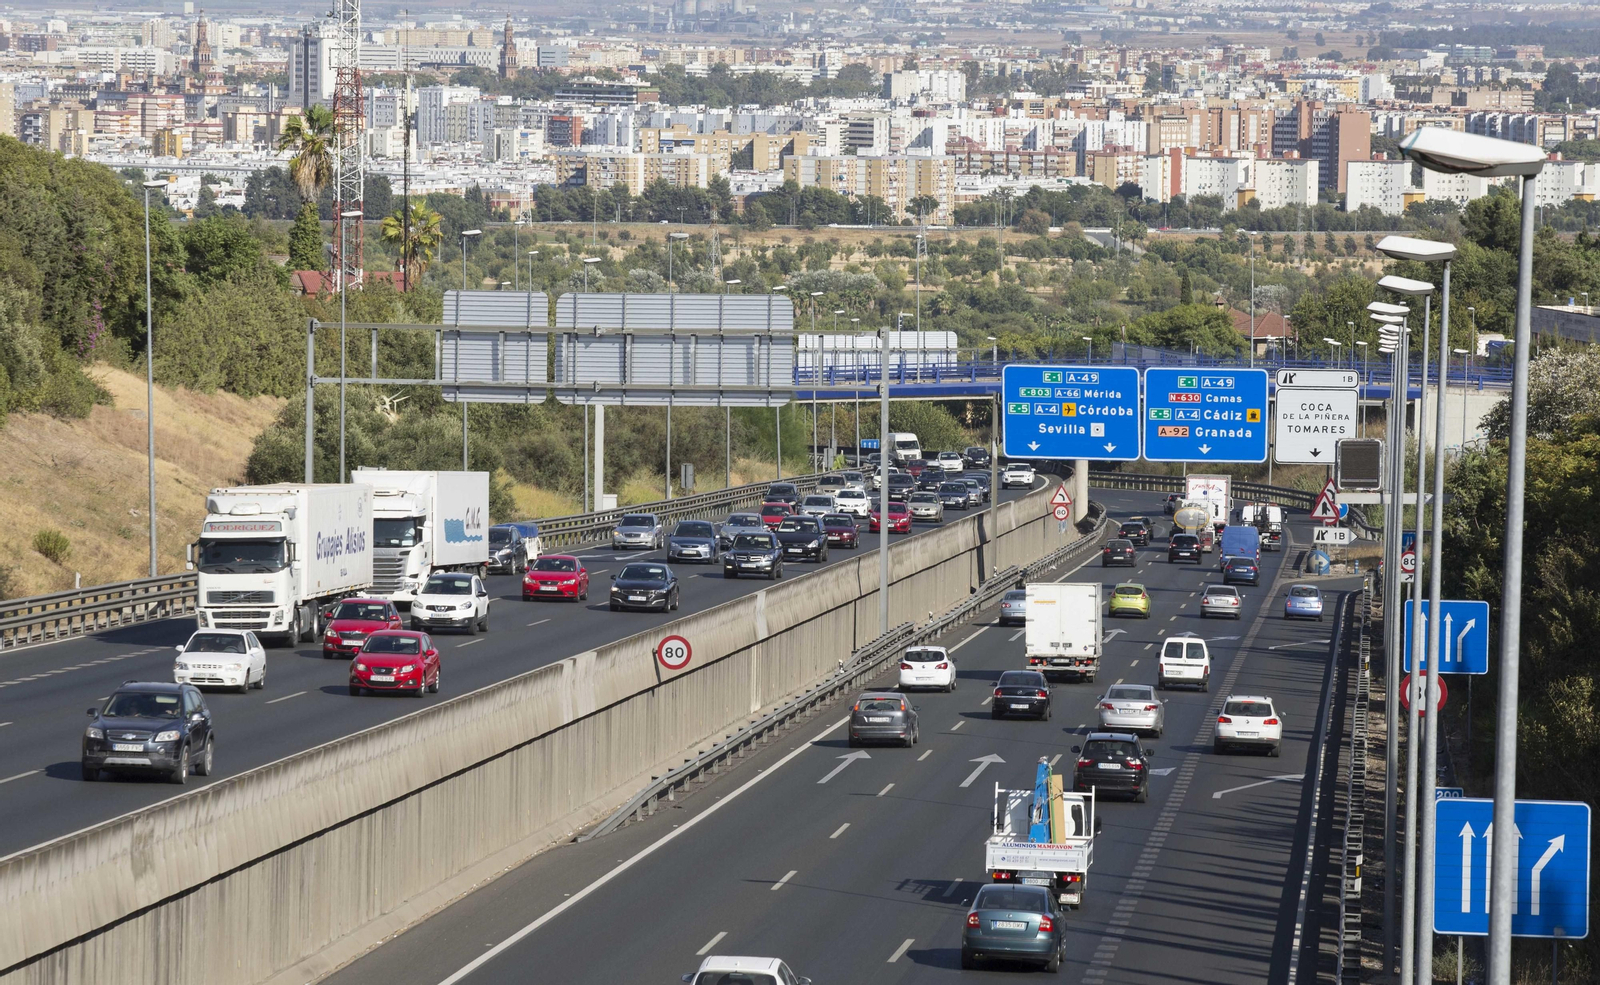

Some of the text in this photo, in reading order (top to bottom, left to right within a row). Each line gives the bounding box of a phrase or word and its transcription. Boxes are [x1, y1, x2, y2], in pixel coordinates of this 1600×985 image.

[1044, 373, 1098, 382] E-1 A-49
[1180, 378, 1233, 387] E-1 A-49
[1084, 390, 1122, 398] Mérida
[1205, 394, 1242, 403] Camas
[1010, 404, 1133, 416] E-5 A-4 Córdoba
[1300, 403, 1332, 411] COCA
[1151, 410, 1242, 420] E-5 A-4 Cádiz
[1038, 423, 1085, 434] Sevilla
[1195, 427, 1252, 438] Granada
[1287, 425, 1346, 434] TOMARES
[316, 529, 343, 564] Grupajes
[665, 647, 684, 658] 80
[1436, 790, 1460, 798] 200
